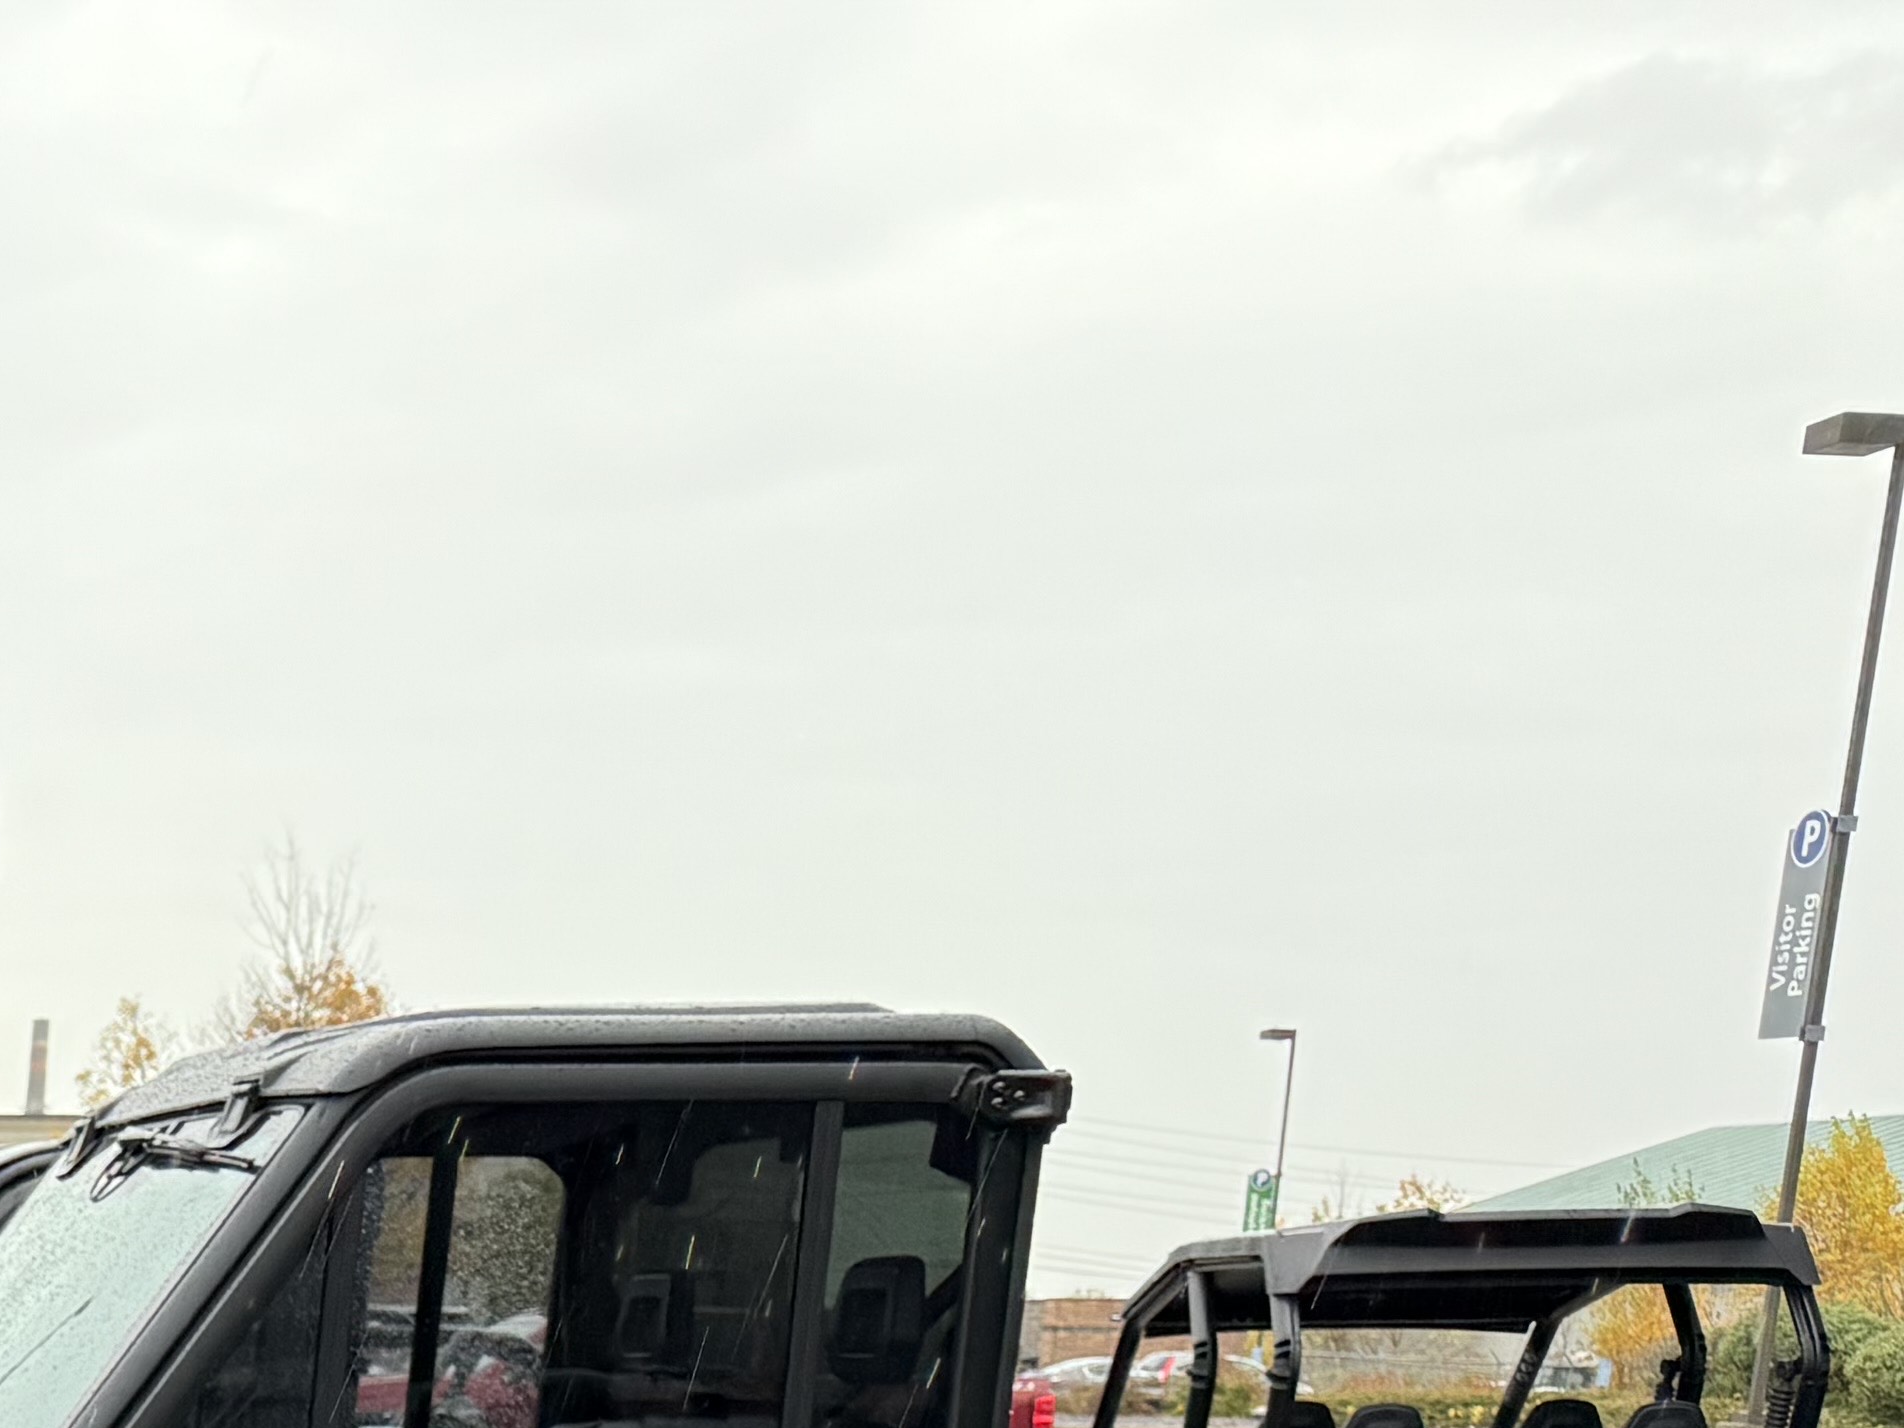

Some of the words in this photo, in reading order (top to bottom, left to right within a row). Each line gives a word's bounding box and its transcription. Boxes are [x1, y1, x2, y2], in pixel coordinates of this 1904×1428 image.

[1801, 819, 1821, 857] P
[1769, 903, 1797, 992] Visitor
[1787, 892, 1821, 997] Parking
